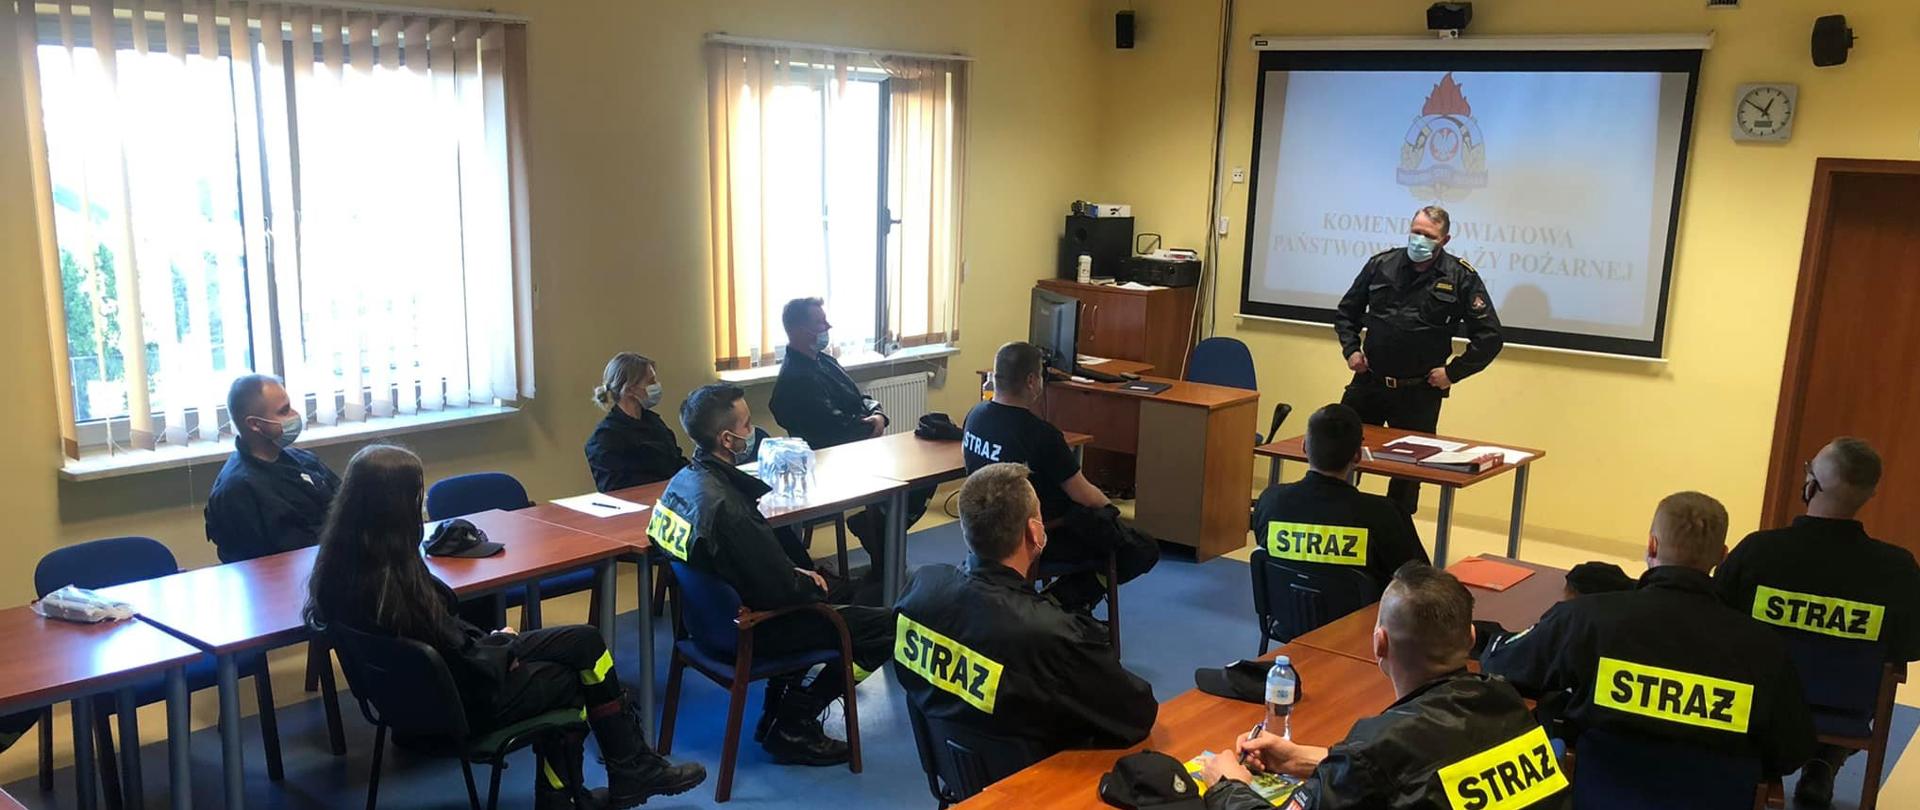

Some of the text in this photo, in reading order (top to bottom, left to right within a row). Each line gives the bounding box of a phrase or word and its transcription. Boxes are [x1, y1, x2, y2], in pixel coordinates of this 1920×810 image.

[1273, 231, 1396, 258] PAŃSTWOW
[1323, 212, 1576, 248] KOMEND OWIATOWA
